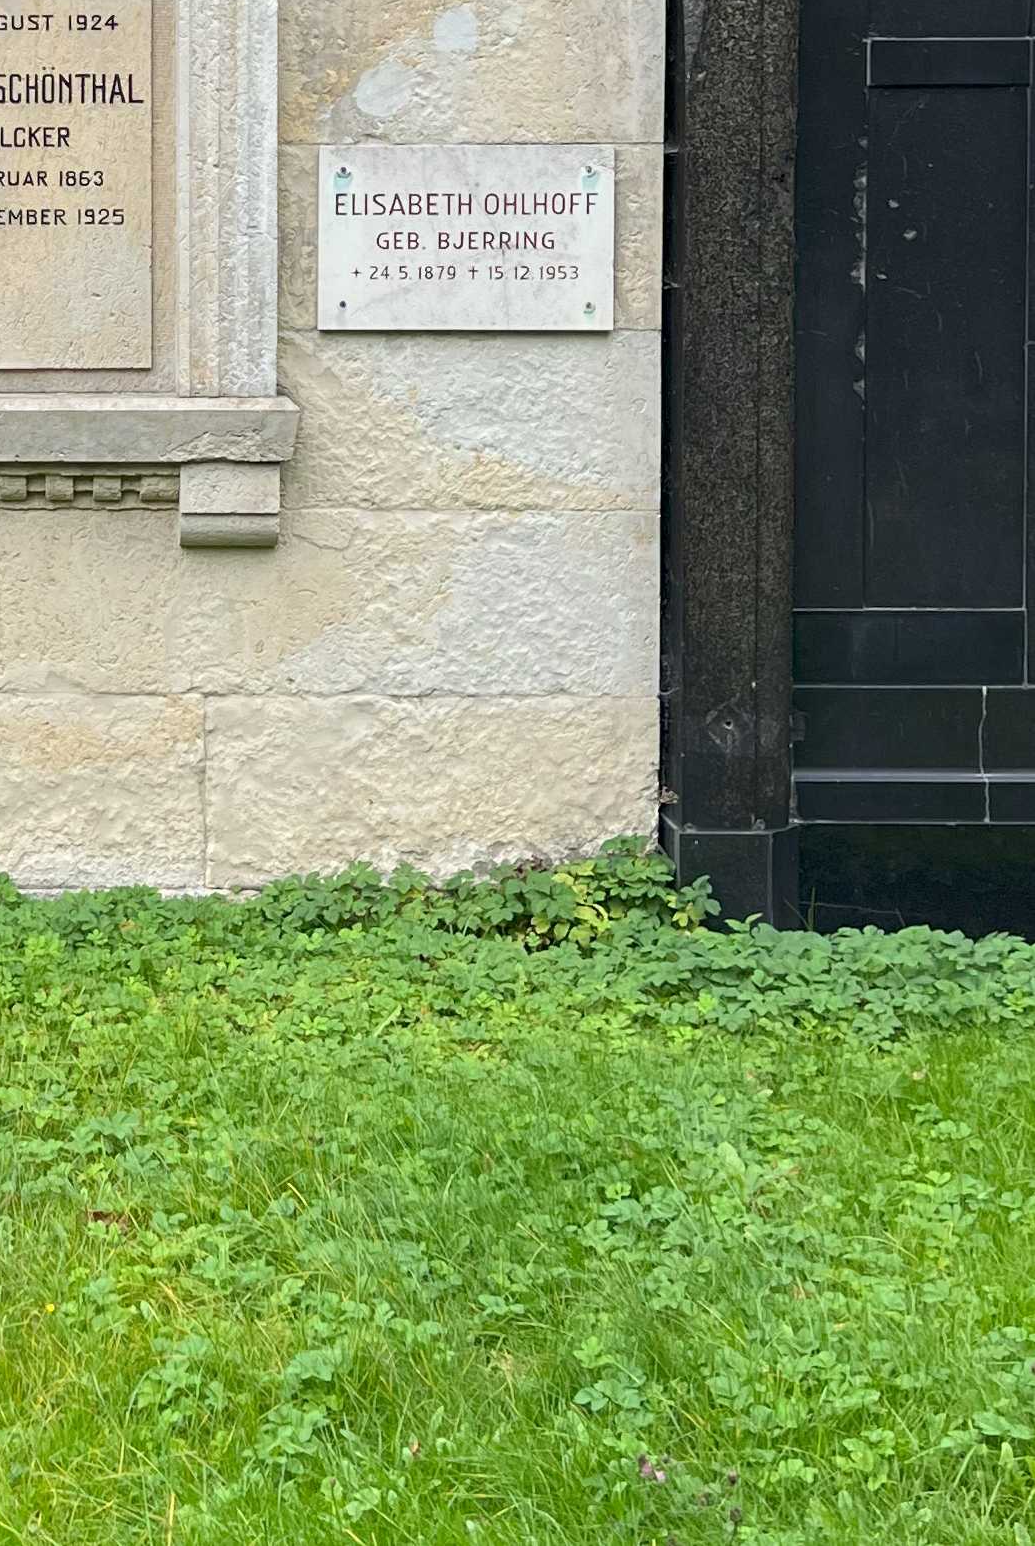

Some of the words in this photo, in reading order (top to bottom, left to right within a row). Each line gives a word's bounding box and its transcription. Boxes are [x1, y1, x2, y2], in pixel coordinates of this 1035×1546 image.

[68, 14, 119, 32] 1924
[59, 171, 105, 187] 1863
[334, 193, 472, 216] ELISABETH
[484, 193, 599, 216] OHLHOFF
[77, 209, 125, 226] 1925
[376, 232, 426, 250] GEB.
[438, 231, 555, 250] BJERRING
